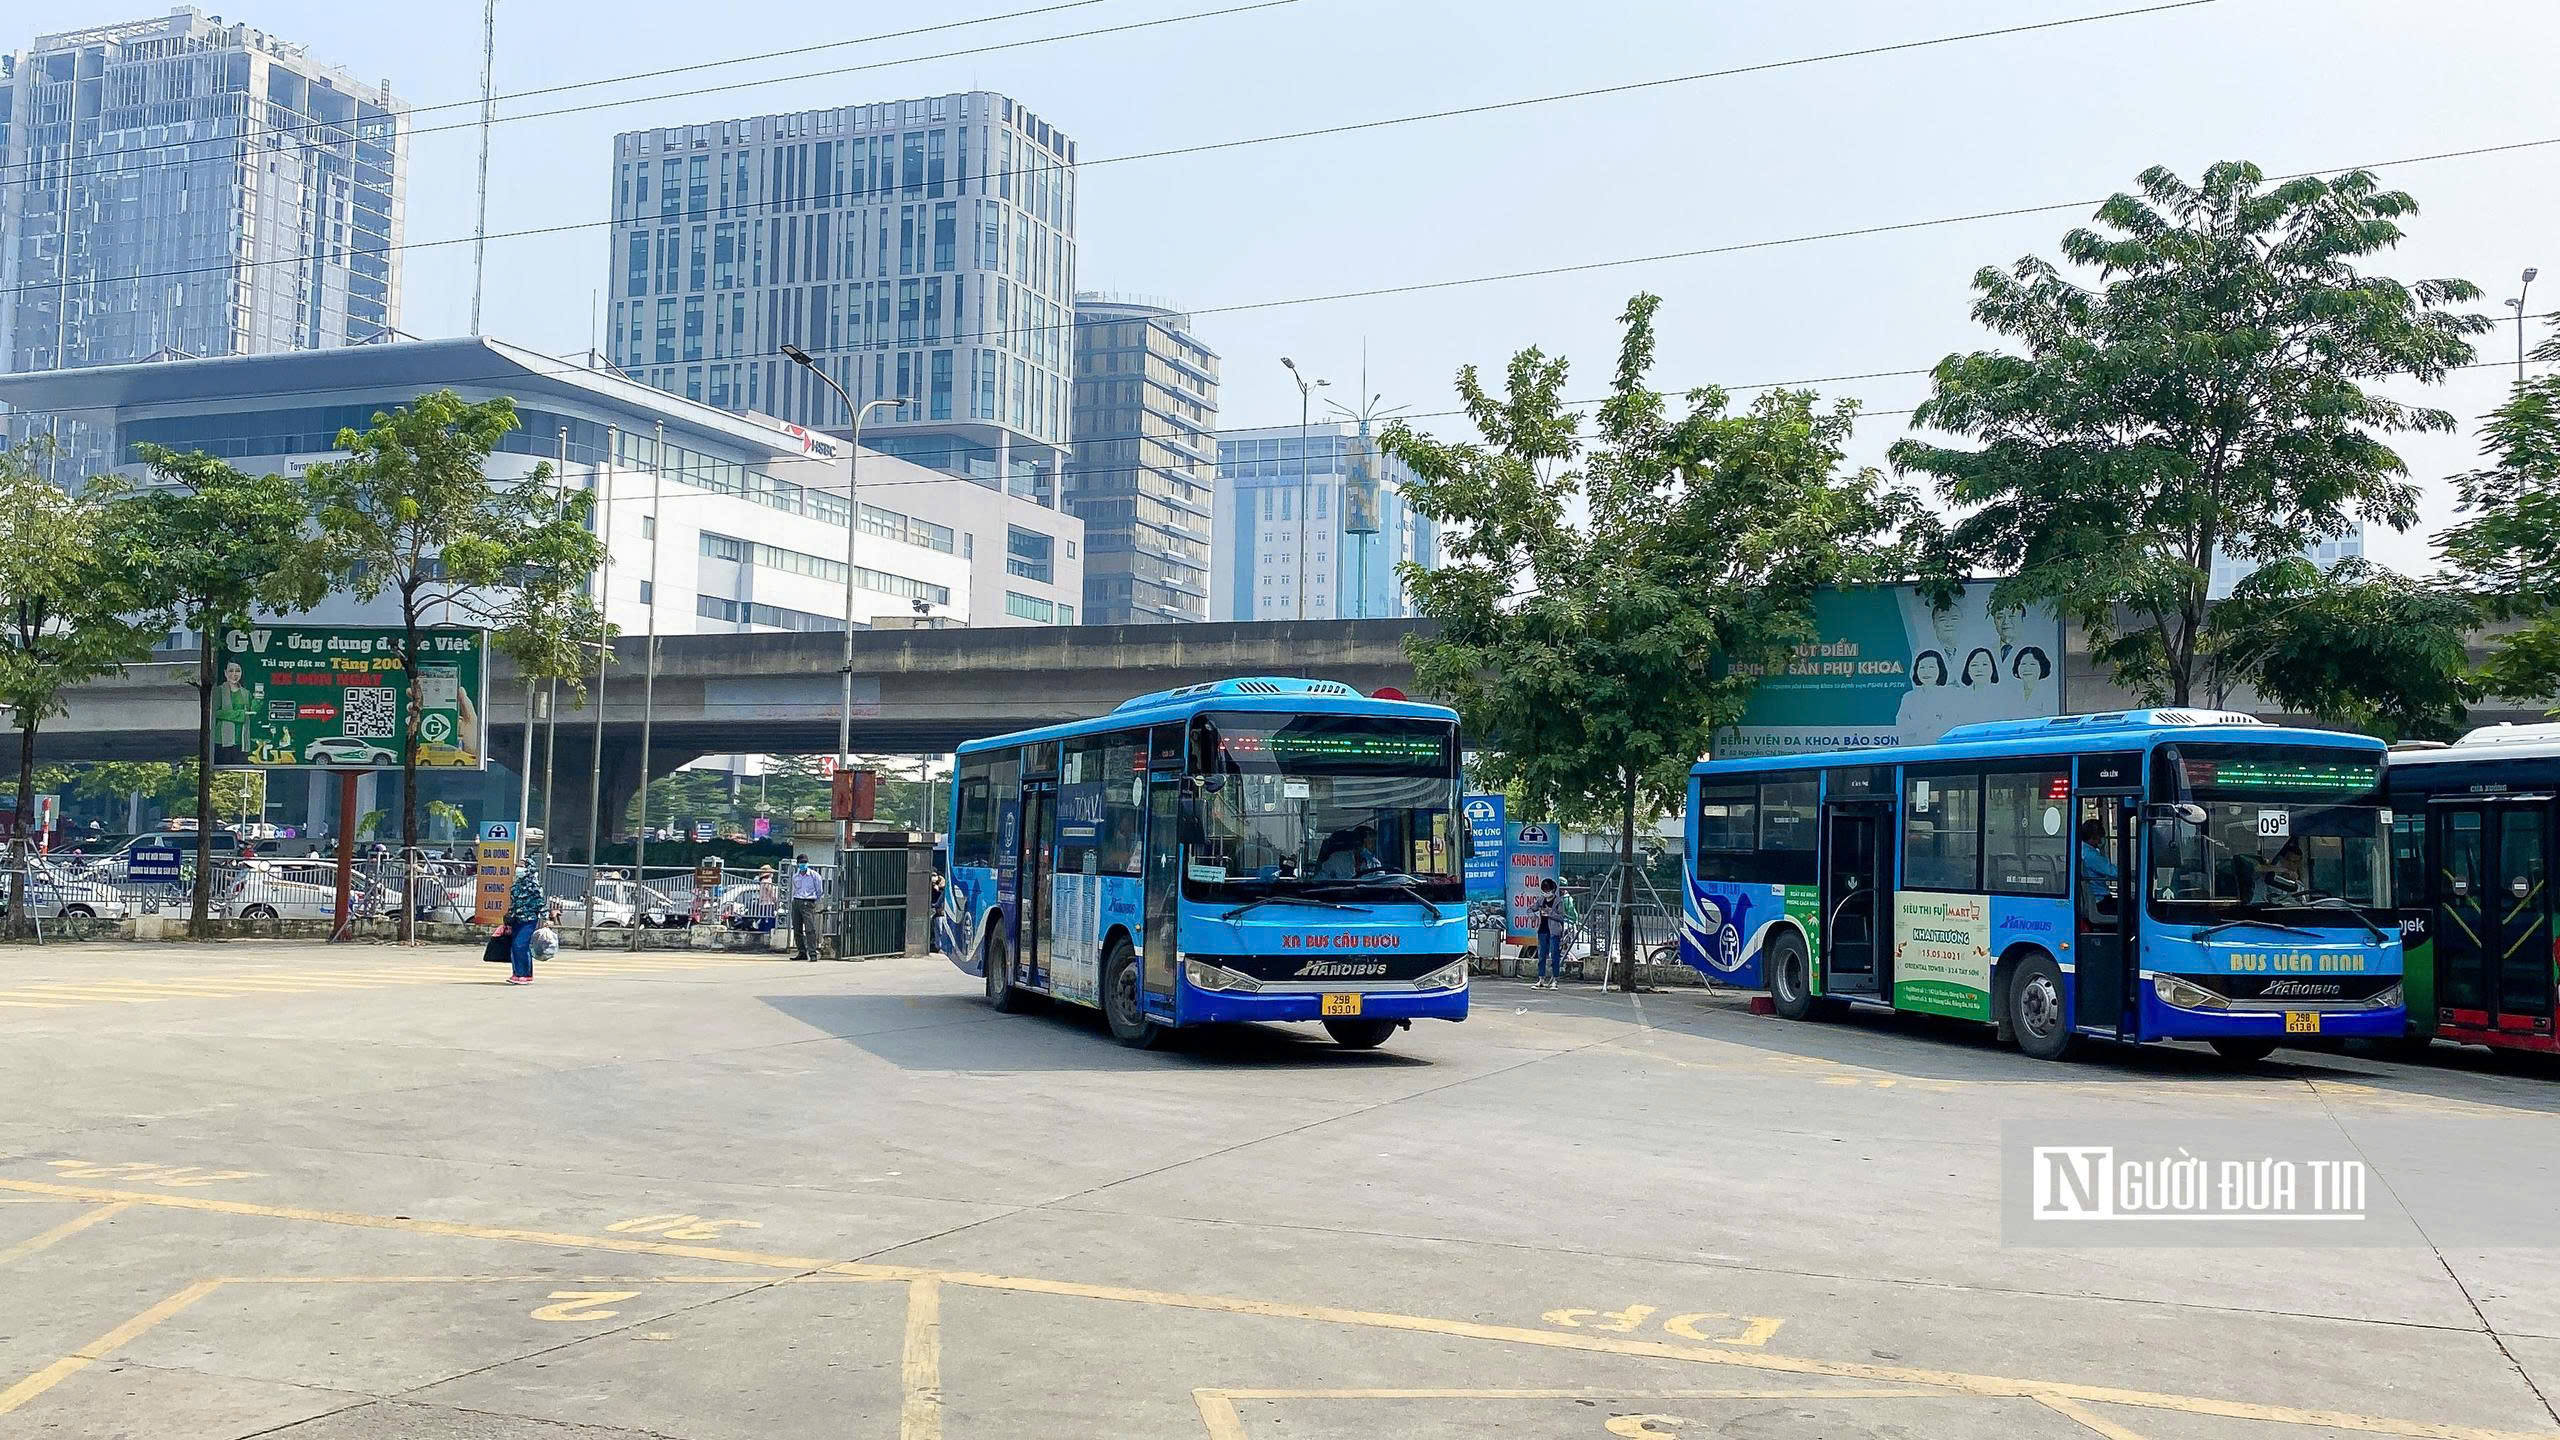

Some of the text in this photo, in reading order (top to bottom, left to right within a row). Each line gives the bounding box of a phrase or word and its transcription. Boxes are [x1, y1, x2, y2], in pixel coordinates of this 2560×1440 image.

[811, 440, 837, 457] HSBC
[226, 630, 272, 653] GV
[288, 633, 323, 653] Ứng
[327, 636, 372, 653] dụng
[376, 637, 405, 651] đt
[435, 637, 471, 653] Việt
[1820, 637, 1859, 656] ĐIỂM
[278, 660, 296, 669] app
[330, 657, 369, 672] Tặng
[1789, 659, 1819, 676] SẢN
[1823, 661, 1855, 677] PHỤ
[1858, 660, 1904, 674] KHOA
[1721, 732, 1899, 747] BỆNH VIỆN ĐA KHOA BẢO SƠN
[1903, 903, 1918, 914] SIÊU
[1306, 936, 1329, 948] BUS
[1333, 930, 1359, 948] CẦU
[1913, 928, 1969, 944] KHAI TRƯƠNG
[1922, 949, 1960, 960] 15.05.2021
[2231, 949, 2364, 971] BUS LIÊN NINH
[1294, 960, 1387, 976] HANOIBUS
[2260, 980, 2340, 995] HANOIBUS
[1333, 995, 1350, 1005] 29B
[1328, 1005, 1356, 1014] 193.01
[2295, 1013, 2311, 1022] 29B
[530, 1290, 642, 1322] 2
